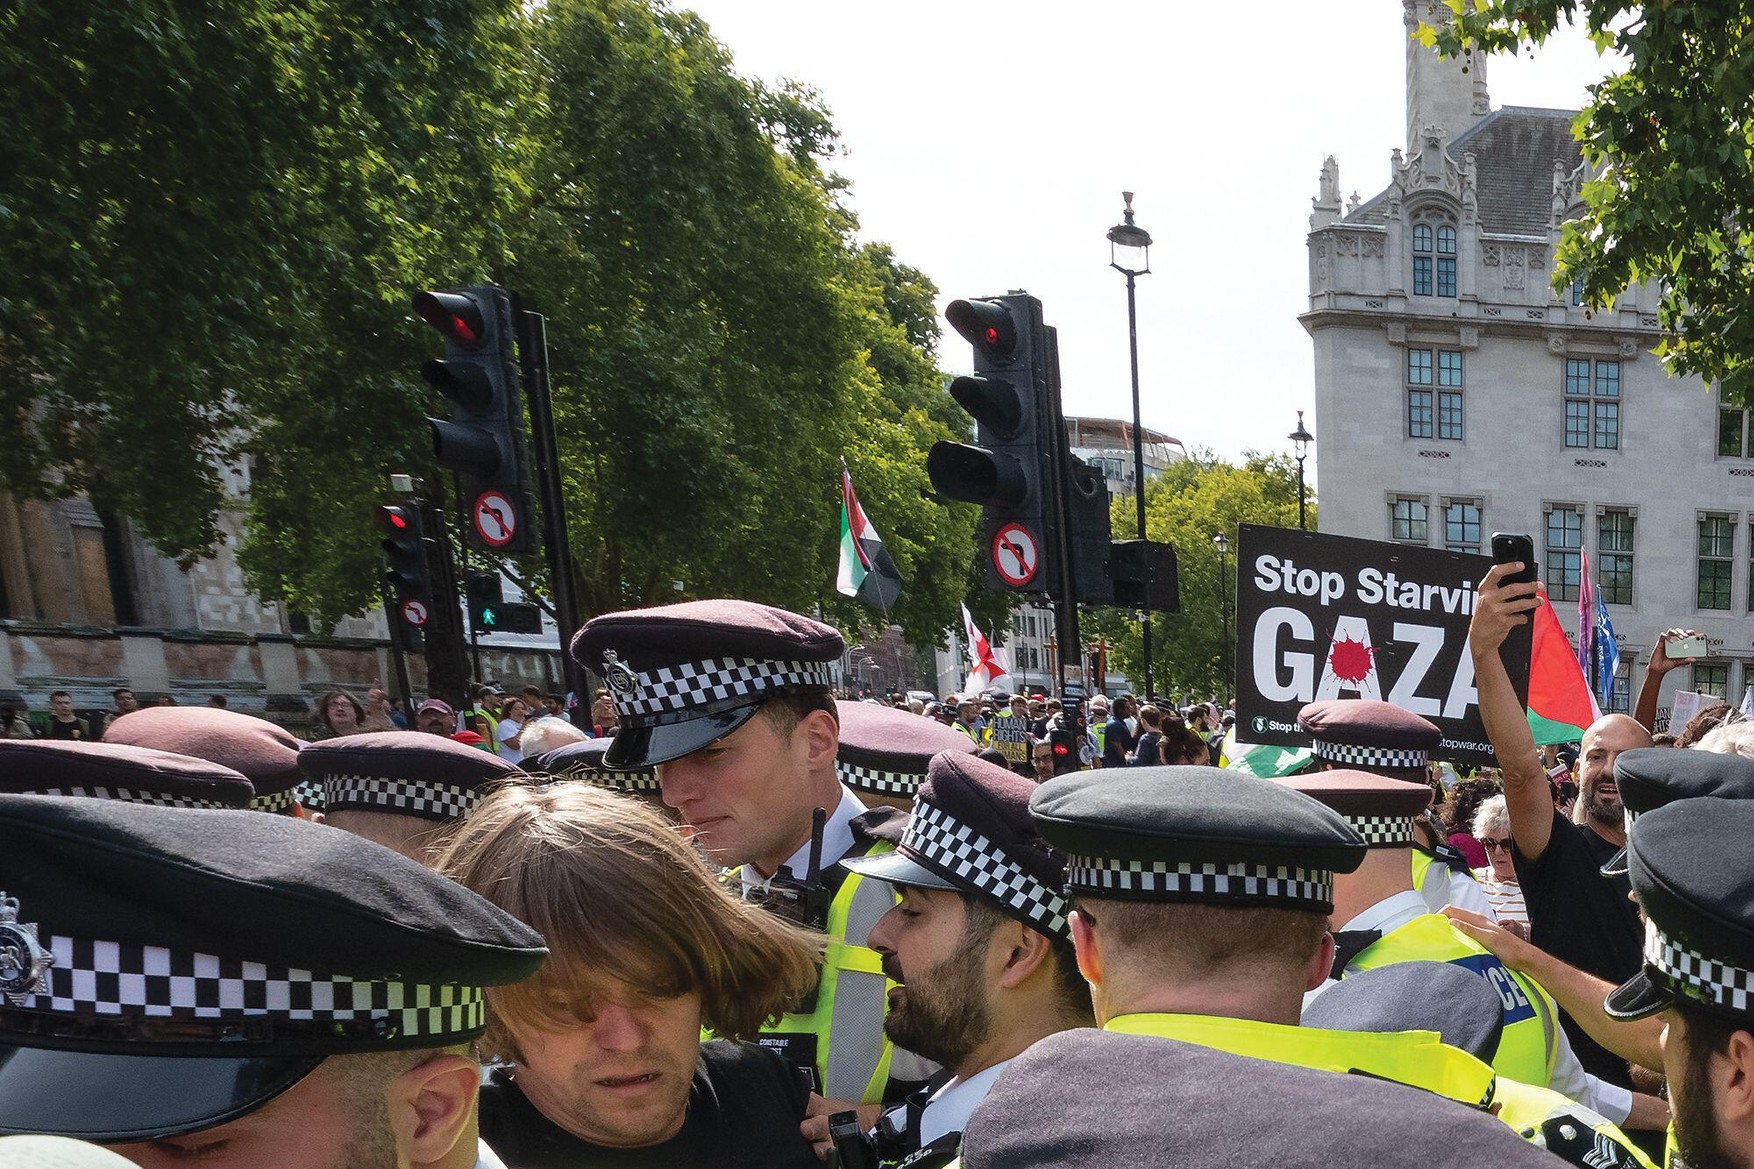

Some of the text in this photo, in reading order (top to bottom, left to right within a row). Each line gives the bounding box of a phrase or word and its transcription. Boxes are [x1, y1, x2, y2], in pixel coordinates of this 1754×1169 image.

[1254, 555, 1480, 616] Stop Starvi
[993, 717, 1027, 730] HUMAN
[1269, 720, 1292, 734] Stop
[993, 729, 1026, 743] RIGHTS
